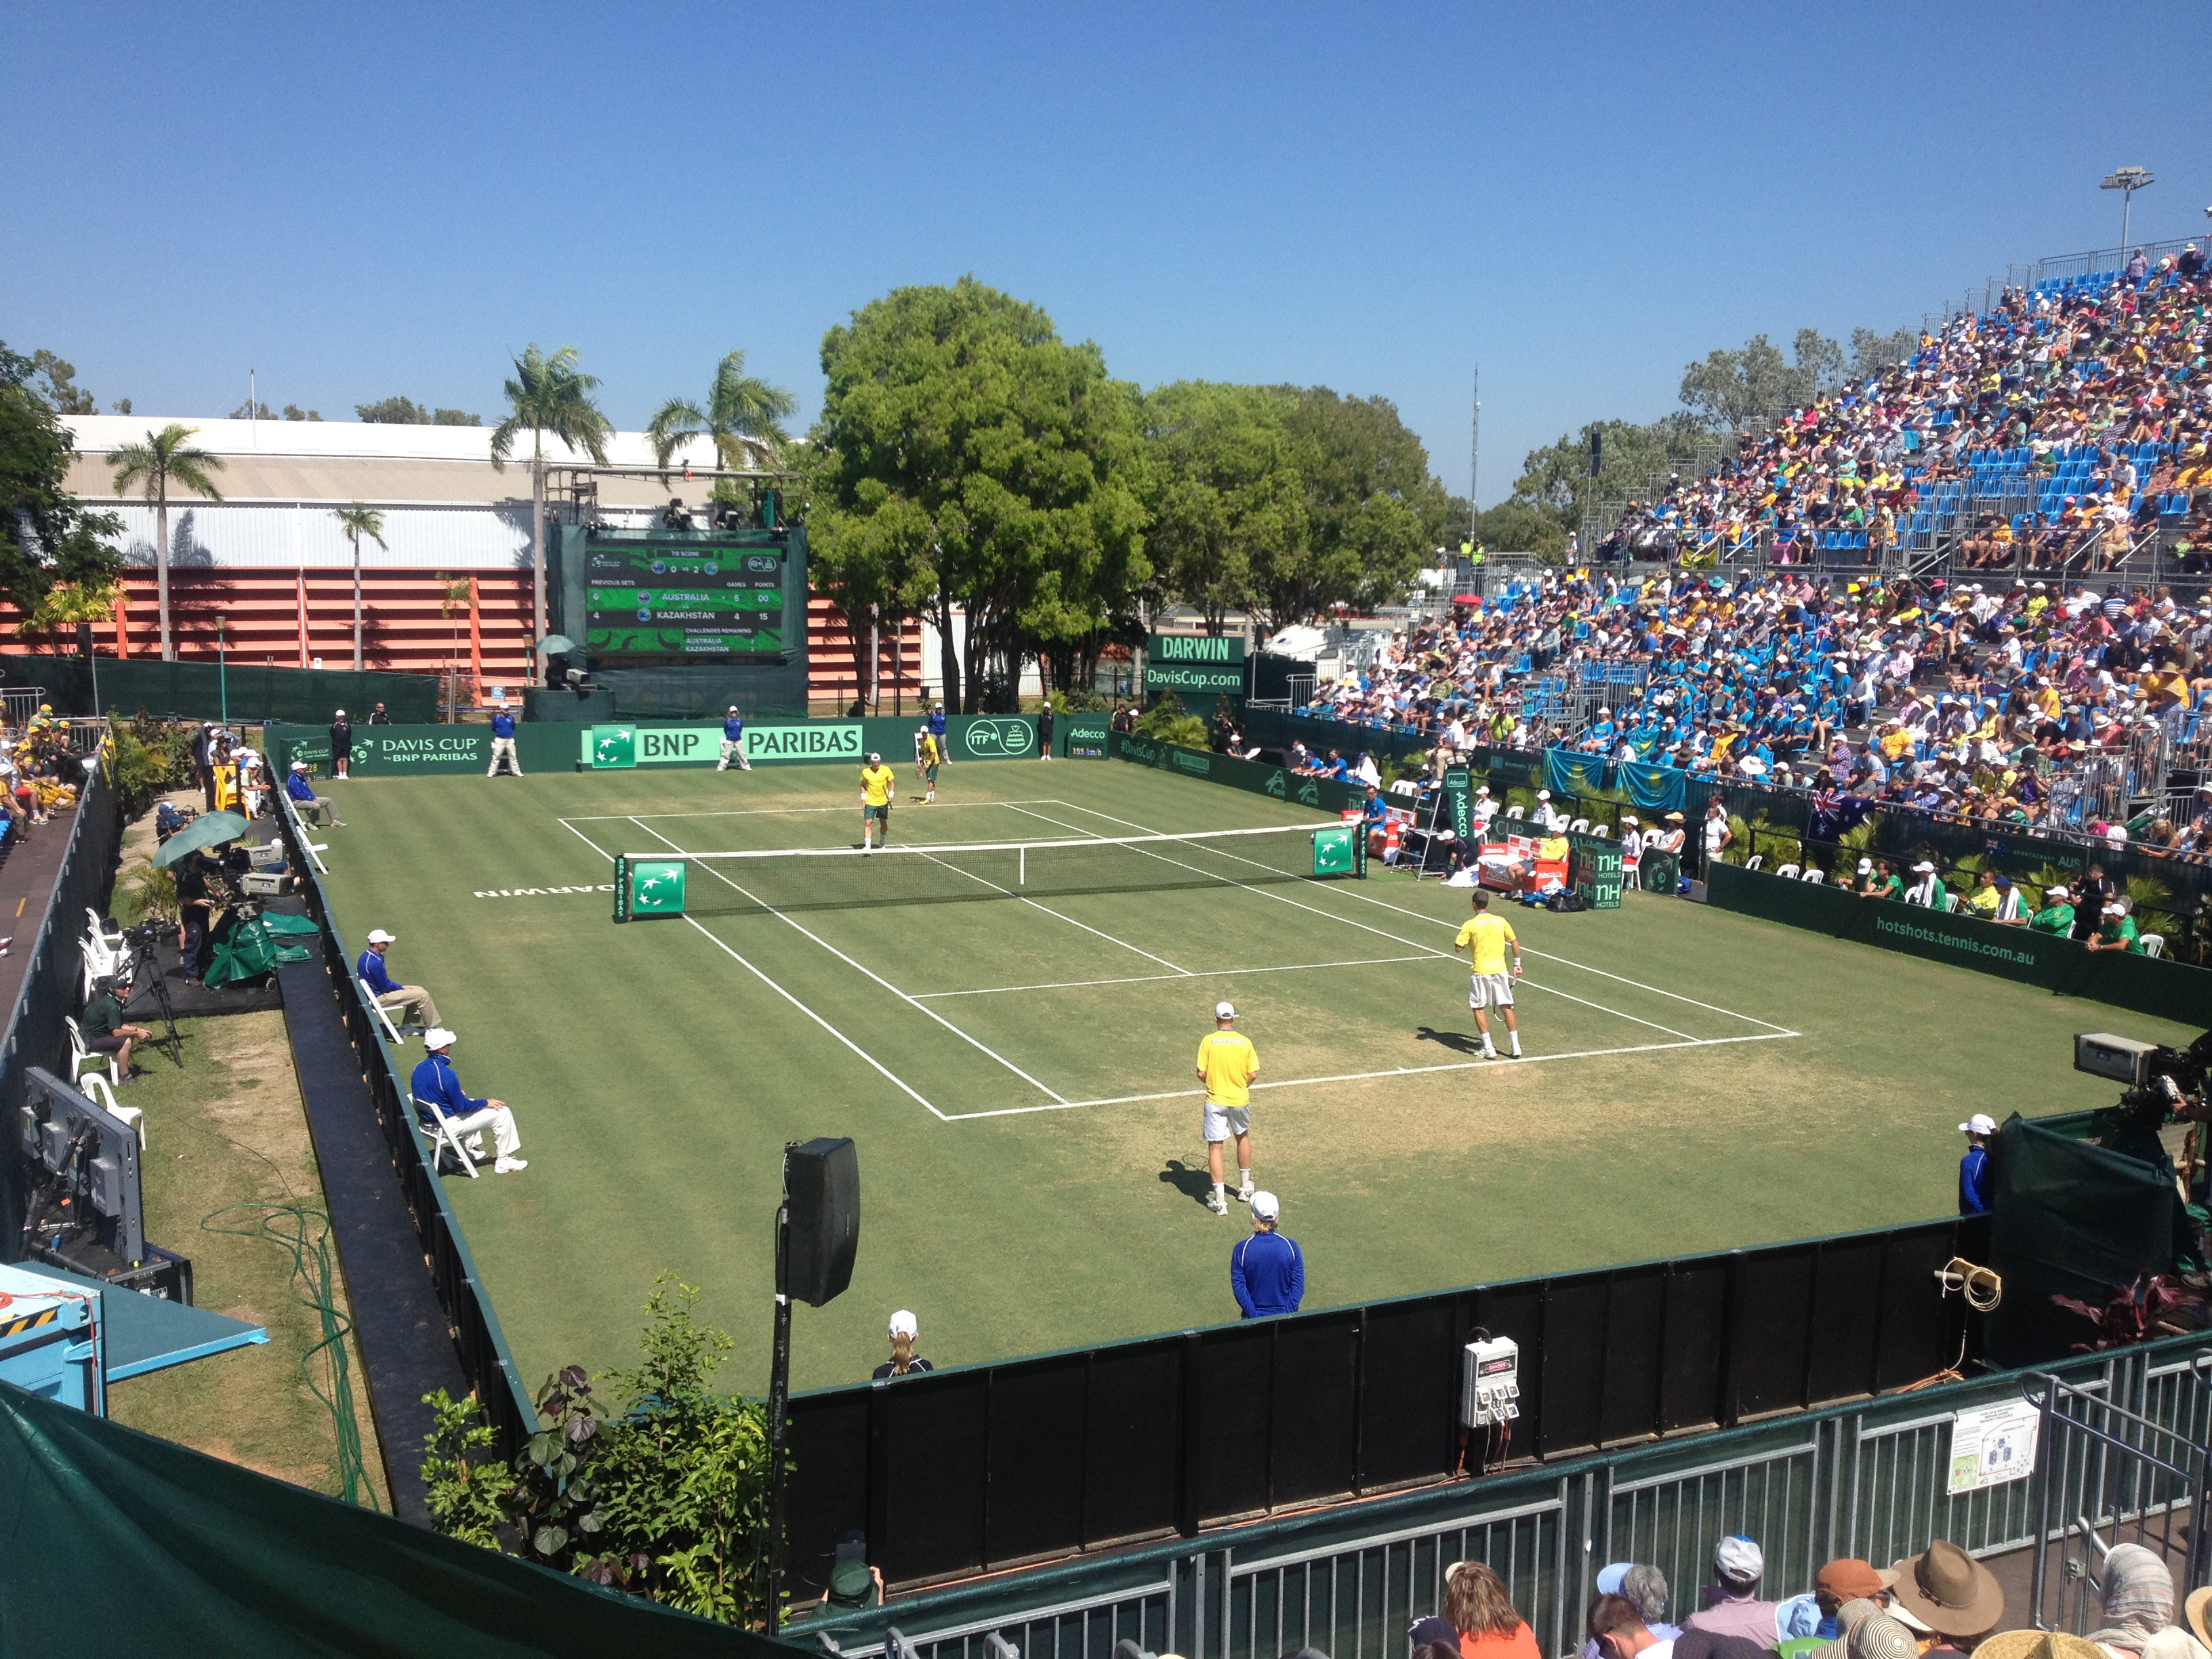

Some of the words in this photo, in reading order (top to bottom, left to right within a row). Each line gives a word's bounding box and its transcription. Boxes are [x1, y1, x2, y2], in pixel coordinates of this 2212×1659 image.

[693, 565, 699, 573] 2
[657, 611, 715, 619] KAZAKHSTAN
[1162, 637, 1229, 660] DARWIN
[1147, 670, 1240, 689] DavisCup.com
[971, 735, 989, 745] ITF
[1070, 728, 1105, 739] Adecco
[382, 739, 434, 752] DAVIS
[438, 738, 477, 750] CUP
[644, 735, 699, 756] BNP
[749, 730, 858, 754] PARIBAS
[392, 754, 419, 762] BNP
[422, 752, 478, 761] PARIBAS
[1120, 739, 1155, 764] #DavisCup
[1456, 792, 1468, 837] Adecco
[1496, 821, 1523, 836] CUP
[2013, 851, 2055, 862] SPORTSCRAFT
[2057, 856, 2081, 867] AUS
[1877, 916, 2035, 966] hotshots.tennis.com.au
